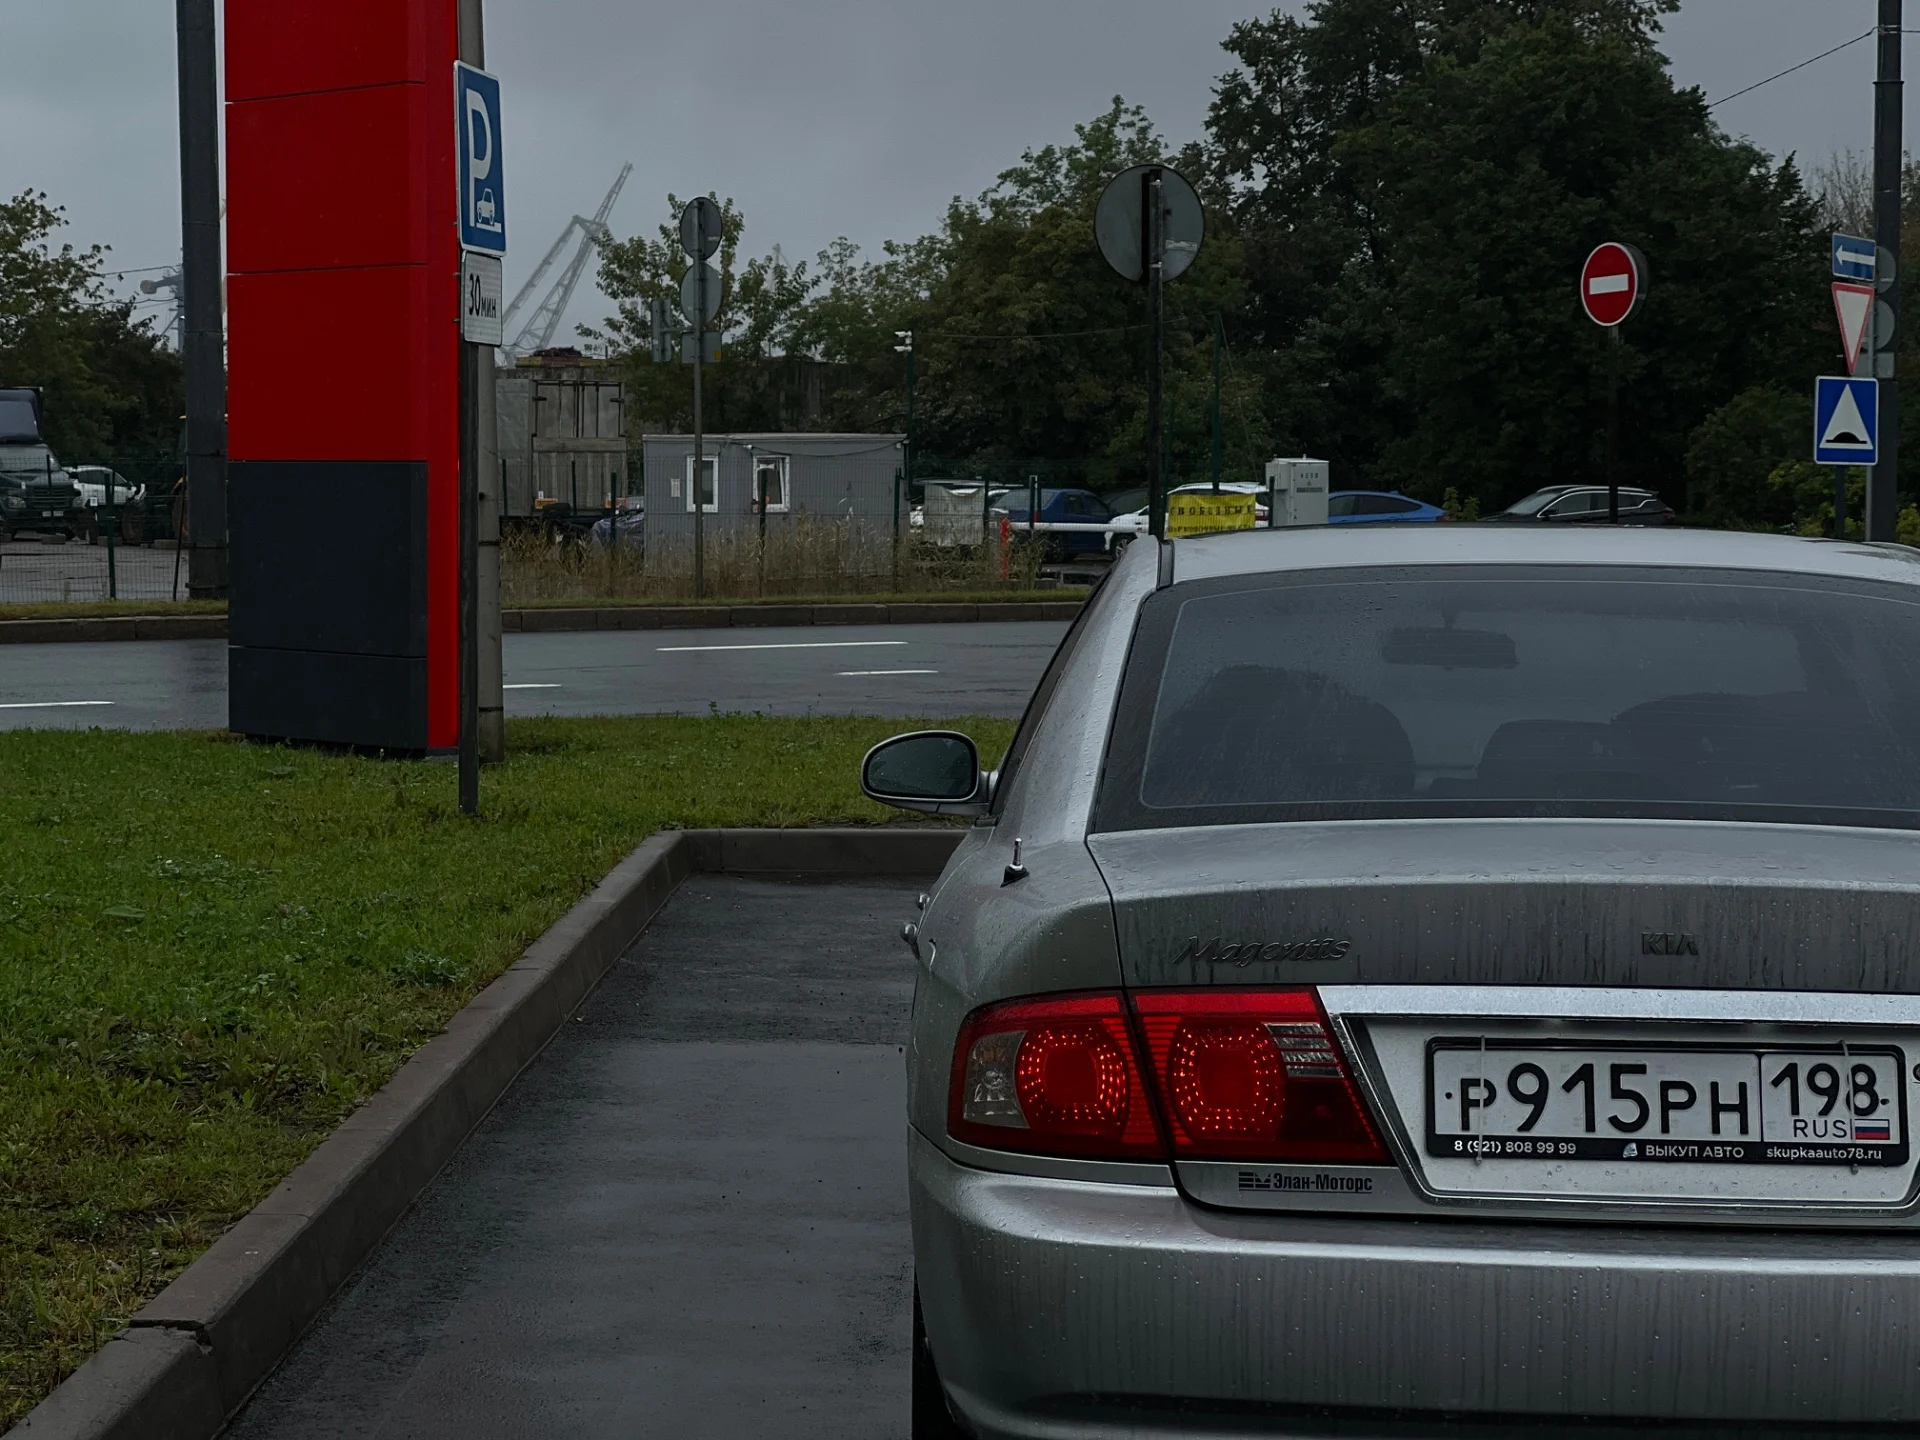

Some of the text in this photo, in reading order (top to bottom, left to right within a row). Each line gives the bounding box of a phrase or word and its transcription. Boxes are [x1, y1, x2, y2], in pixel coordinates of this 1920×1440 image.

[1172, 935, 1351, 967] Magentis
[1641, 931, 1699, 955] KIA
[1771, 1063, 1879, 1116] 198
[1793, 1119, 1847, 1138] RUS
[1454, 1140, 1577, 1155] 8 (921) 808 99 99
[1645, 1145, 1744, 1158] ВЫКУП АВТО
[1766, 1146, 1882, 1160] skupkaauto78.ru
[1273, 1173, 1372, 1192] Элан-Моторс
